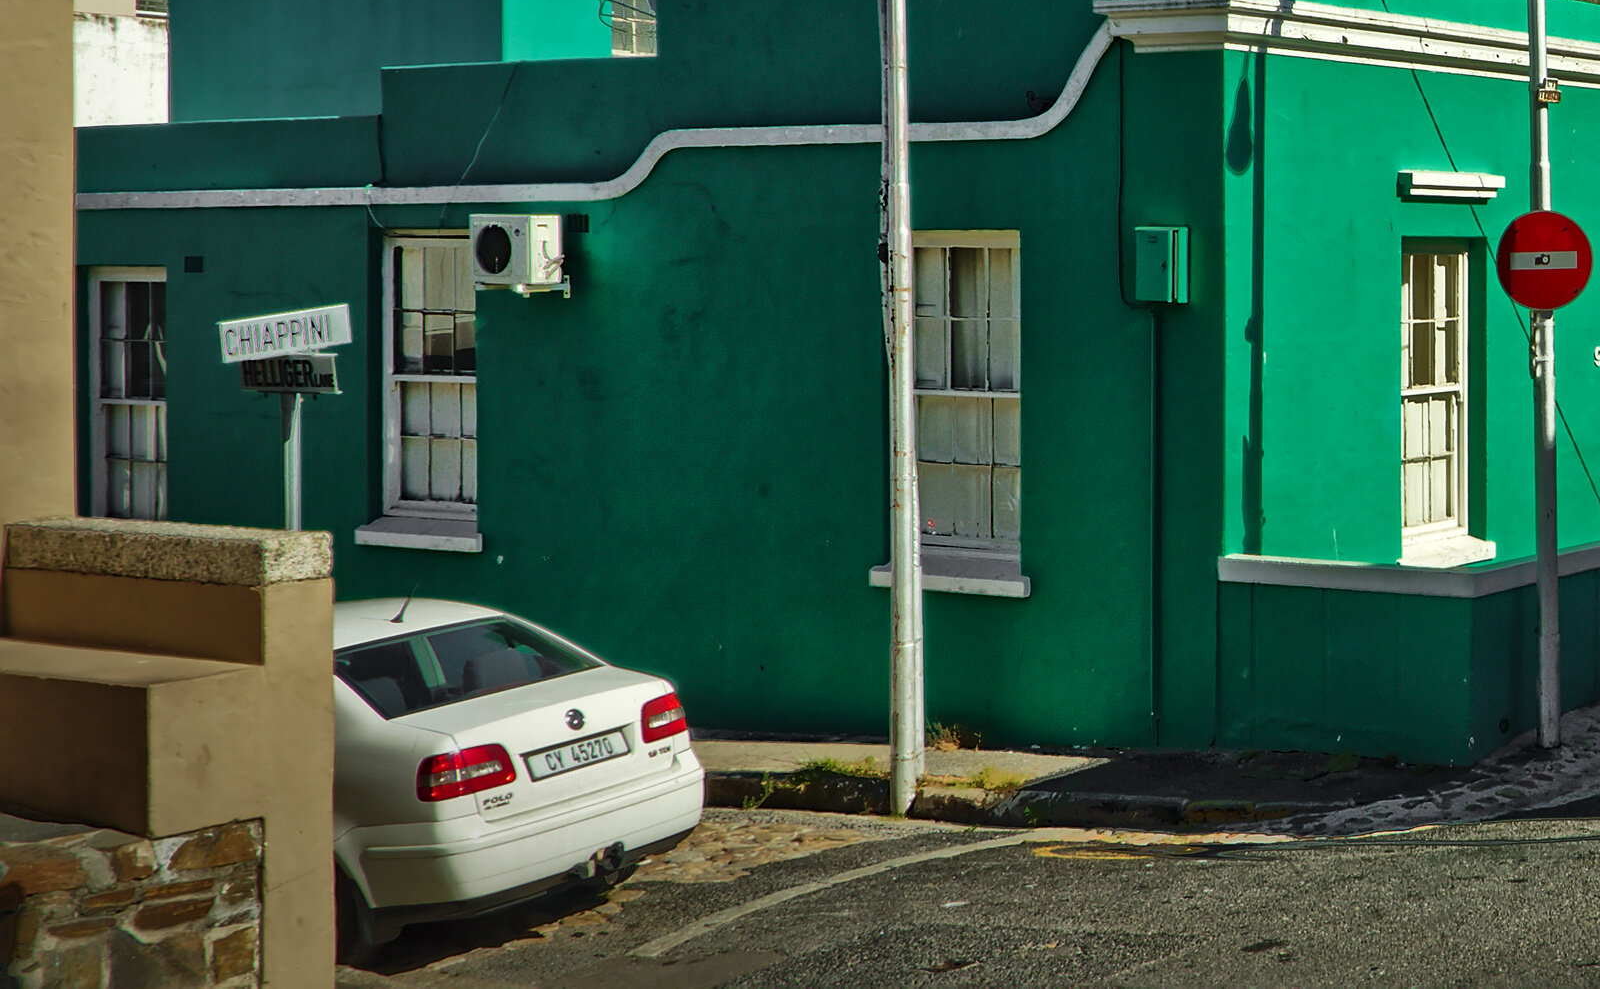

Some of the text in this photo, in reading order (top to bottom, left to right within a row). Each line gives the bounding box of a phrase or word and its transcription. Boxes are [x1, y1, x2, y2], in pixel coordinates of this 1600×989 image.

[223, 314, 331, 357] CHIAPPINI
[242, 359, 314, 388] HELLIGER
[545, 737, 614, 771] CY 45270
[482, 792, 514, 806] POLO
